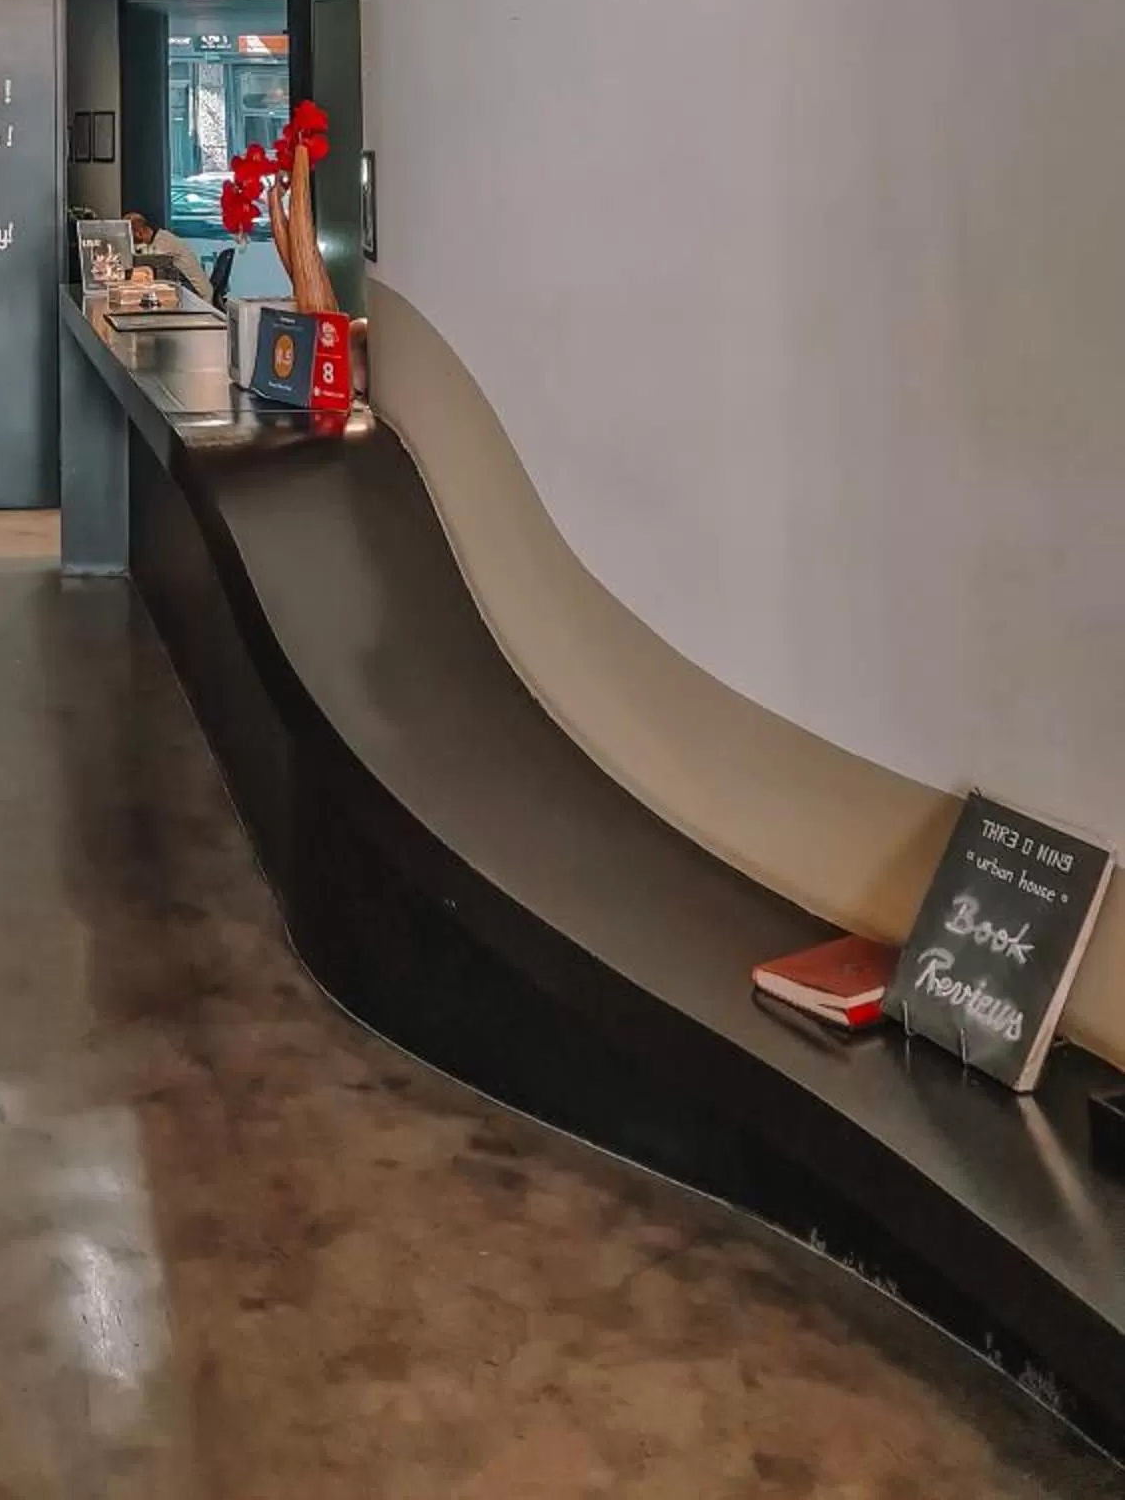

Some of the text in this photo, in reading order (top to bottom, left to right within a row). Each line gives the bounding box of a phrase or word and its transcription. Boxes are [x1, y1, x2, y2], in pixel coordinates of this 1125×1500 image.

[976, 856, 1056, 903] urban house
[944, 894, 1035, 965] Book
